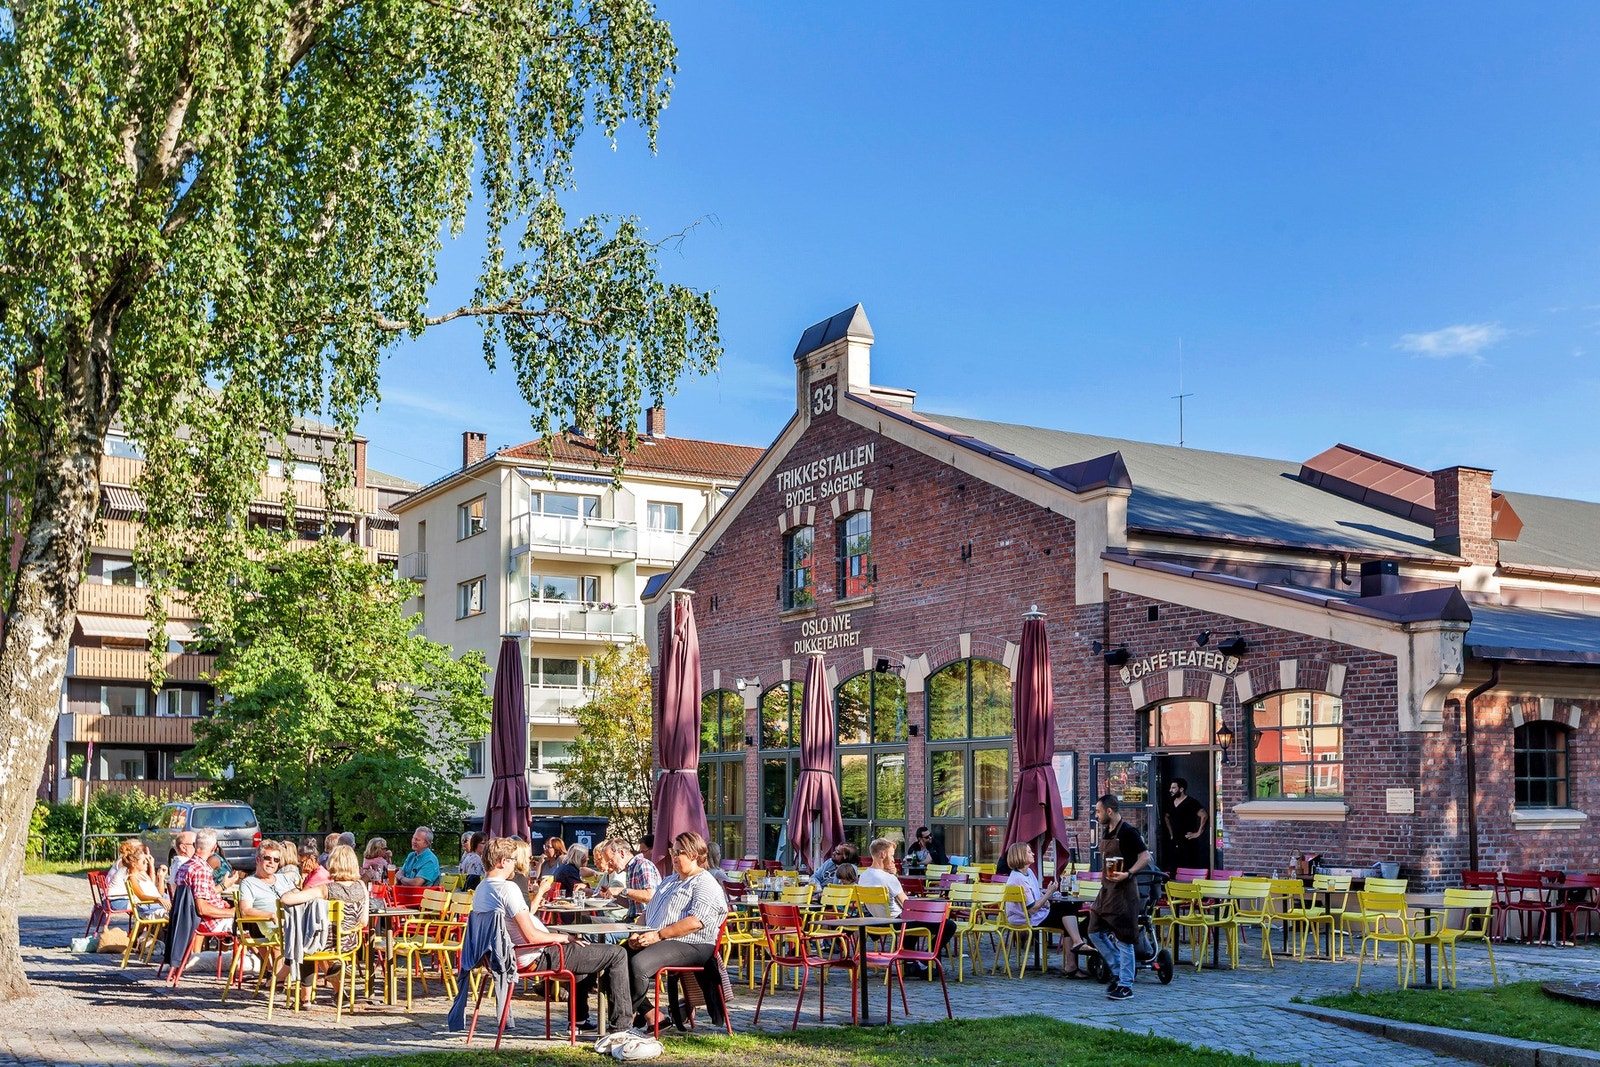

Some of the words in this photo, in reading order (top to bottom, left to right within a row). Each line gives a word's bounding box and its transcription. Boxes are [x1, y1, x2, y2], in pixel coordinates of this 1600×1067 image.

[814, 384, 834, 415] 33
[777, 443, 875, 492] TRIKKESTALLEN
[786, 485, 817, 509] BYDEL
[820, 470, 864, 498] SAGENE
[801, 618, 828, 637] OSLO
[831, 613, 851, 632] NYE
[794, 631, 860, 654] DUKKETEATRET
